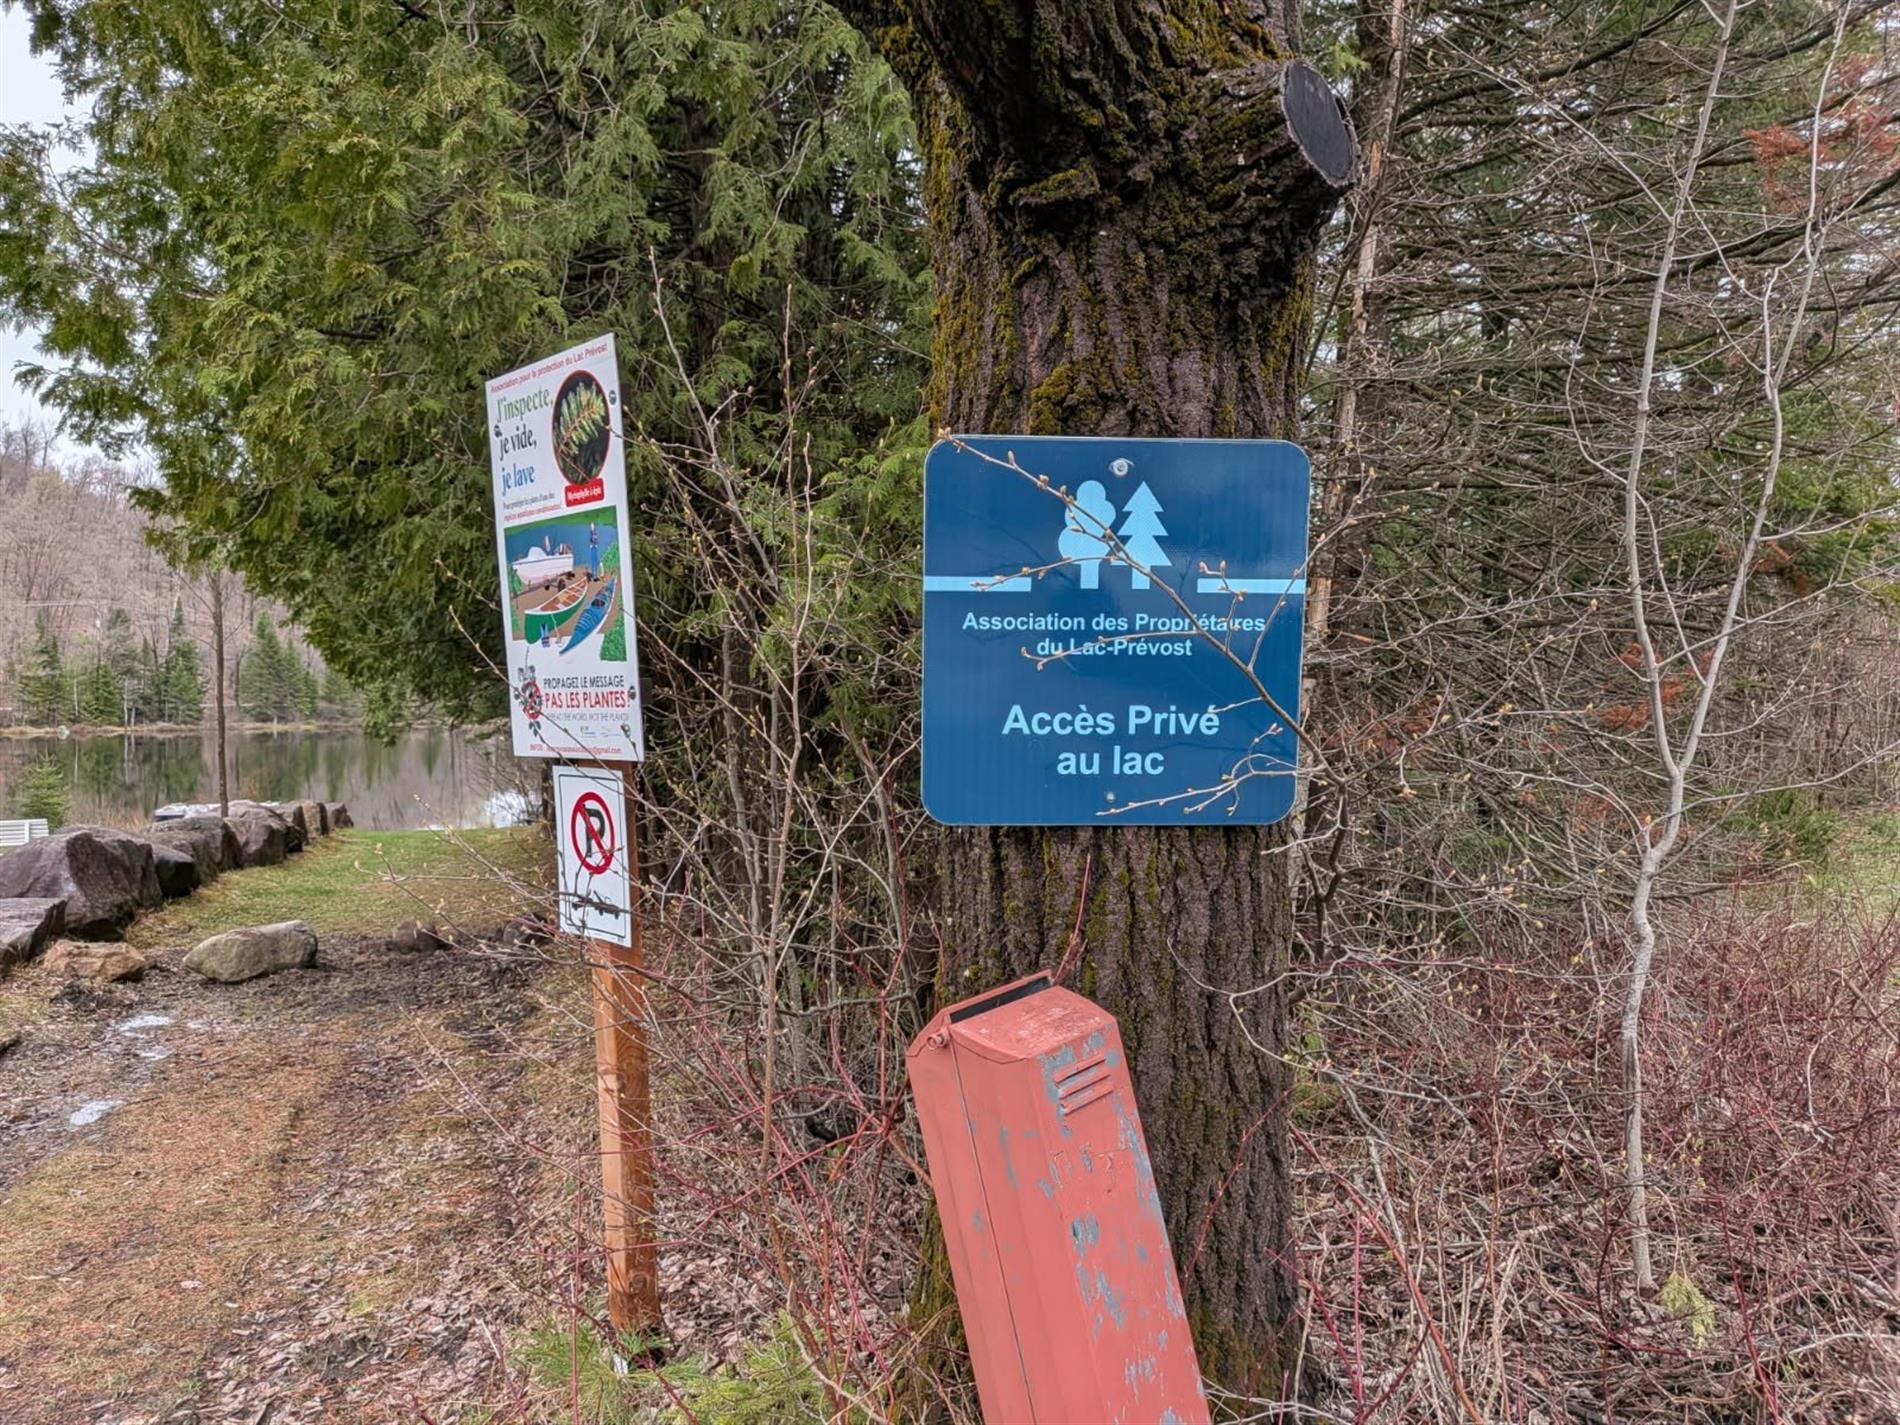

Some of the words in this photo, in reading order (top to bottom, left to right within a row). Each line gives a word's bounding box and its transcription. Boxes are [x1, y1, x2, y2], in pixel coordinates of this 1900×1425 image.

[490, 376, 519, 393] Association
[520, 372, 531, 385] pour
[538, 361, 565, 378] protection
[565, 356, 572, 365] du
[573, 352, 584, 363] Lac
[585, 343, 608, 358] Prévost
[496, 388, 553, 423] J'inspecte,
[500, 432, 511, 461] je
[511, 424, 537, 452] vide,
[501, 467, 511, 496] je
[513, 463, 535, 488] lave
[962, 612, 1085, 631] Association
[1090, 612, 1128, 631] des
[1037, 638, 1063, 655] du
[1070, 638, 1193, 656] Lac-Prévost
[544, 677, 579, 690] PROPAGEZ
[581, 676, 588, 689] LE
[589, 675, 625, 688] MESSAGE
[545, 692, 562, 709] PAS
[565, 691, 580, 709] LES
[583, 690, 625, 709] PLANTES
[1001, 704, 1115, 735] Accès
[1128, 704, 1220, 735] Privé
[1057, 752, 1100, 775] au
[1113, 745, 1165, 775] lac
[584, 804, 606, 858] P
